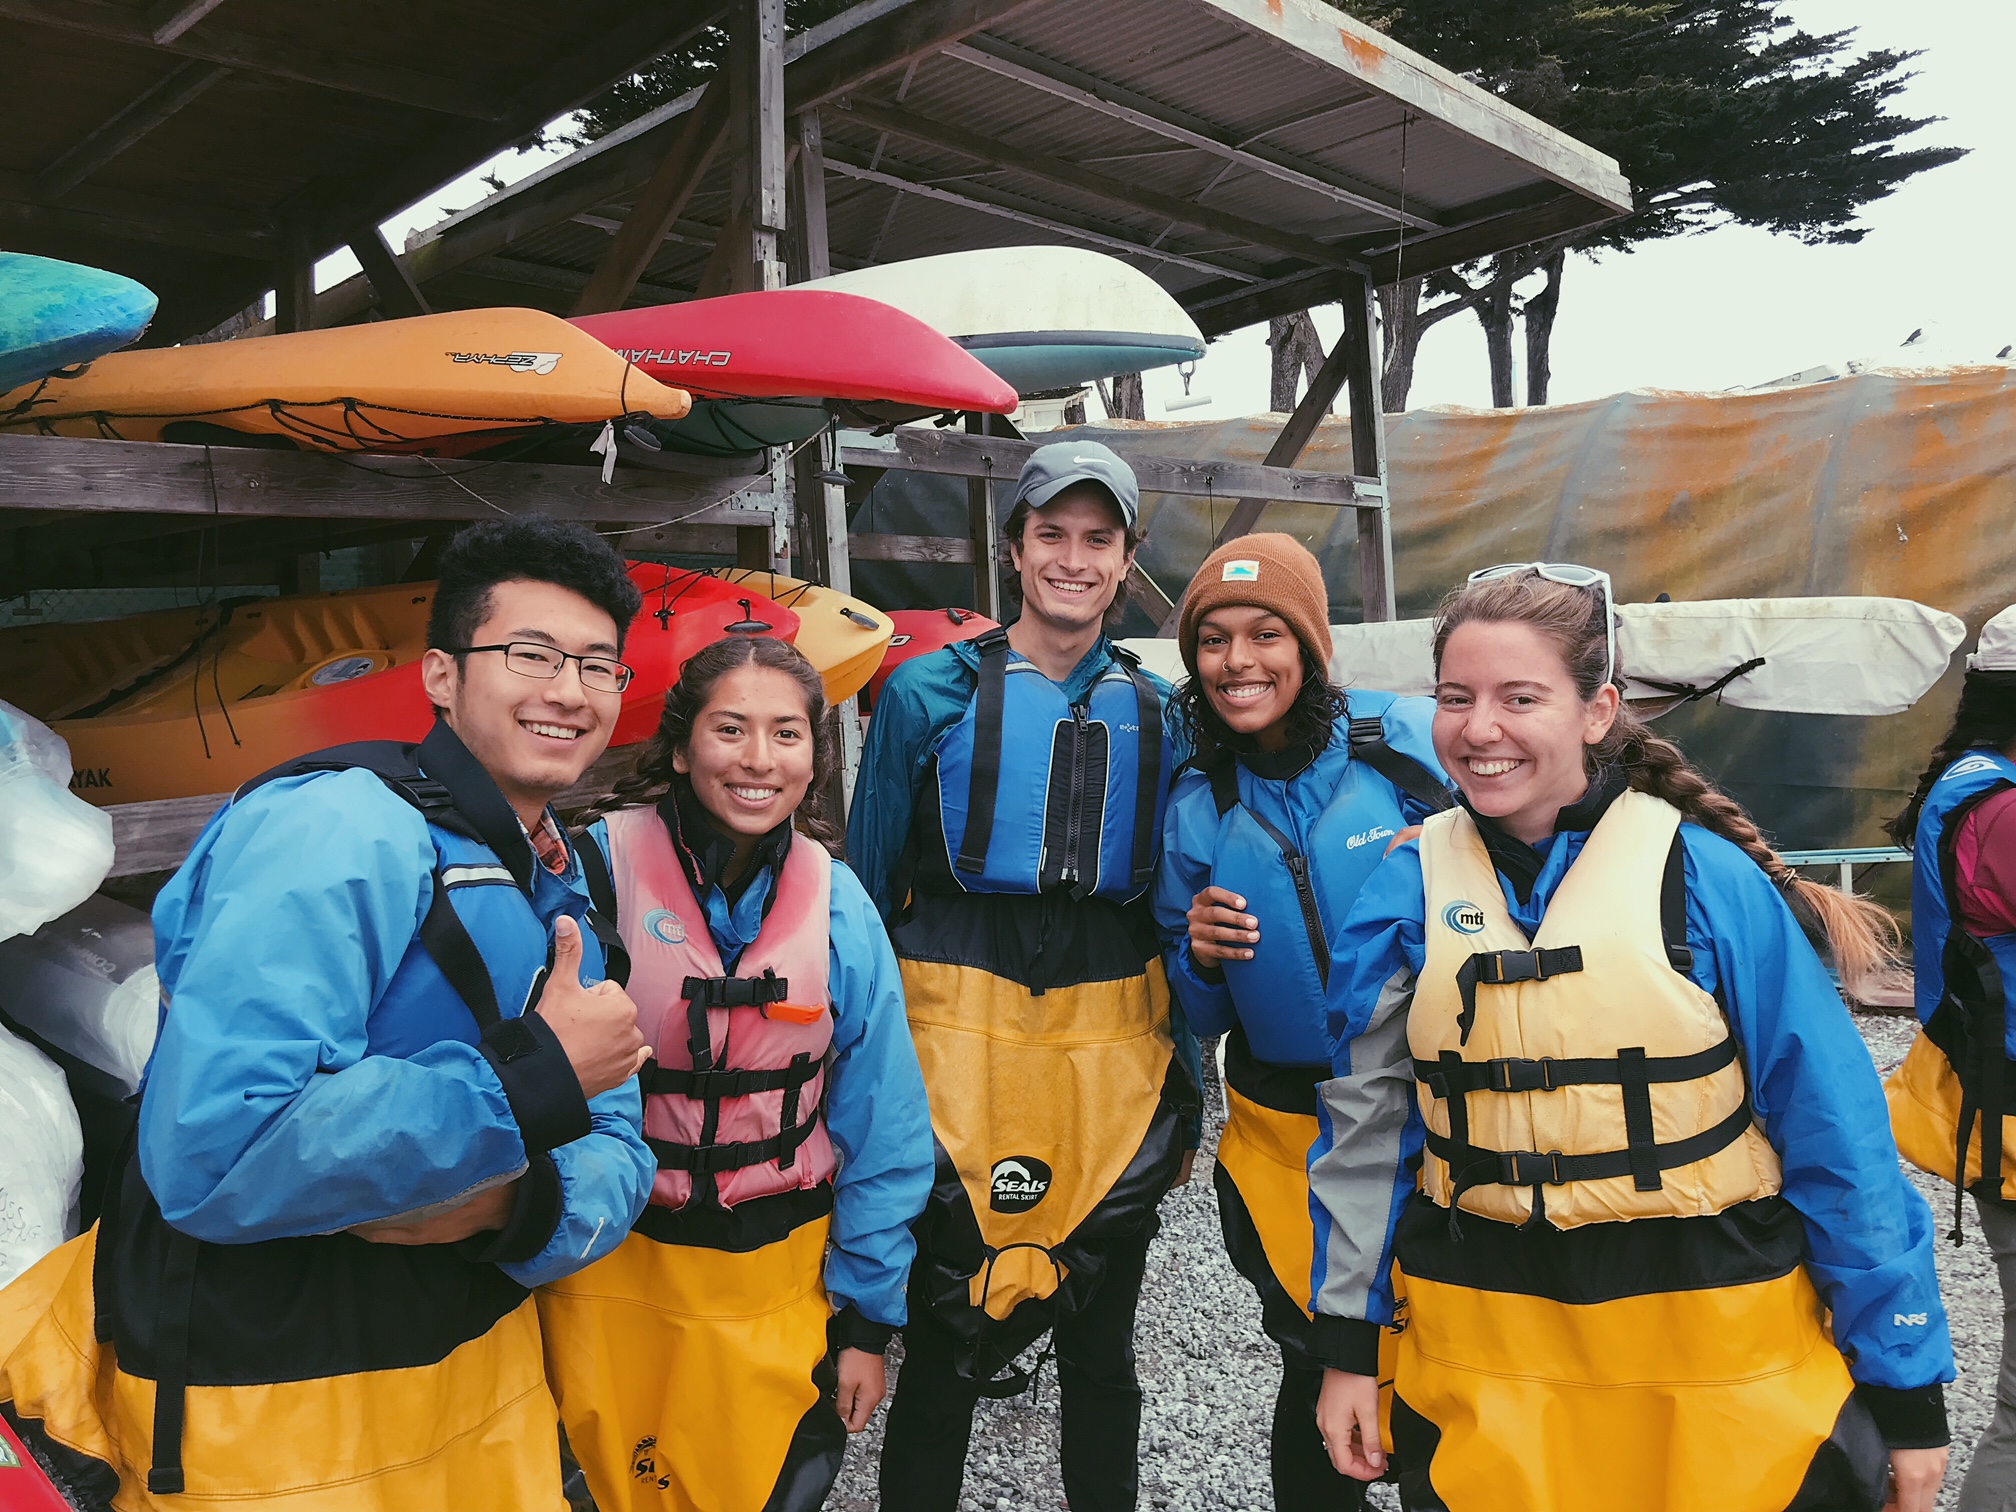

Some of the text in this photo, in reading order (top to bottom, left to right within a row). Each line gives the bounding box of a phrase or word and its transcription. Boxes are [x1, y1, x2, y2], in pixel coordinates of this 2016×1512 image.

[452, 352, 538, 367] ZEPHYR
[69, 768, 113, 788] YAK
[1346, 825, 1395, 850] Old Town
[1460, 912, 1484, 926] mti
[662, 922, 685, 937] mti
[992, 1178, 1048, 1193] SEALS
[998, 1193, 1038, 1201] RENTAL SKIRT
[1893, 1312, 1928, 1327] NRS
